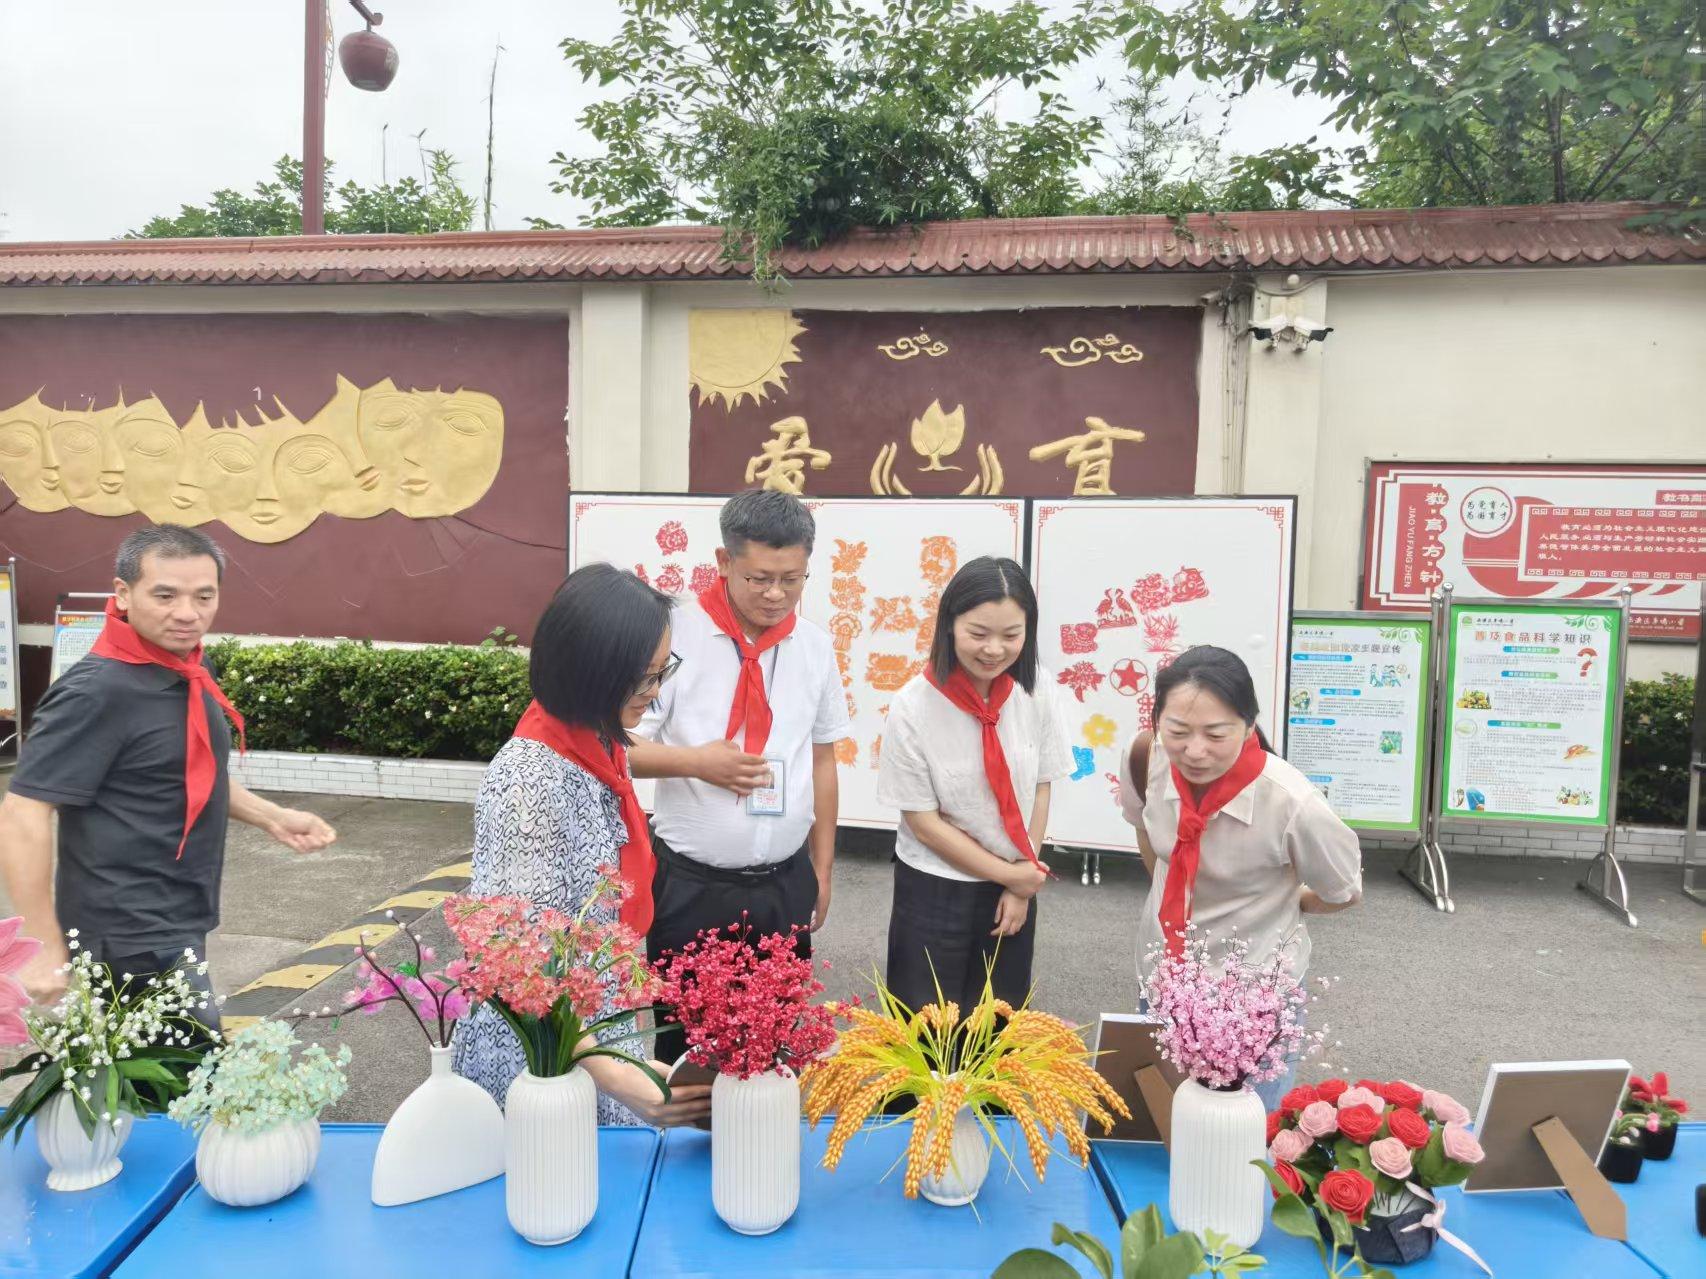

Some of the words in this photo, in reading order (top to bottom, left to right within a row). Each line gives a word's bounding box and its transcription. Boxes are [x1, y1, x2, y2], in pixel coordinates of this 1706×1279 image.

[744, 416, 832, 495] 爱
[1029, 416, 1146, 495] 育
[1407, 527, 1415, 539] YU
[1405, 540, 1414, 563] FANG
[1404, 564, 1413, 588] ZHEN
